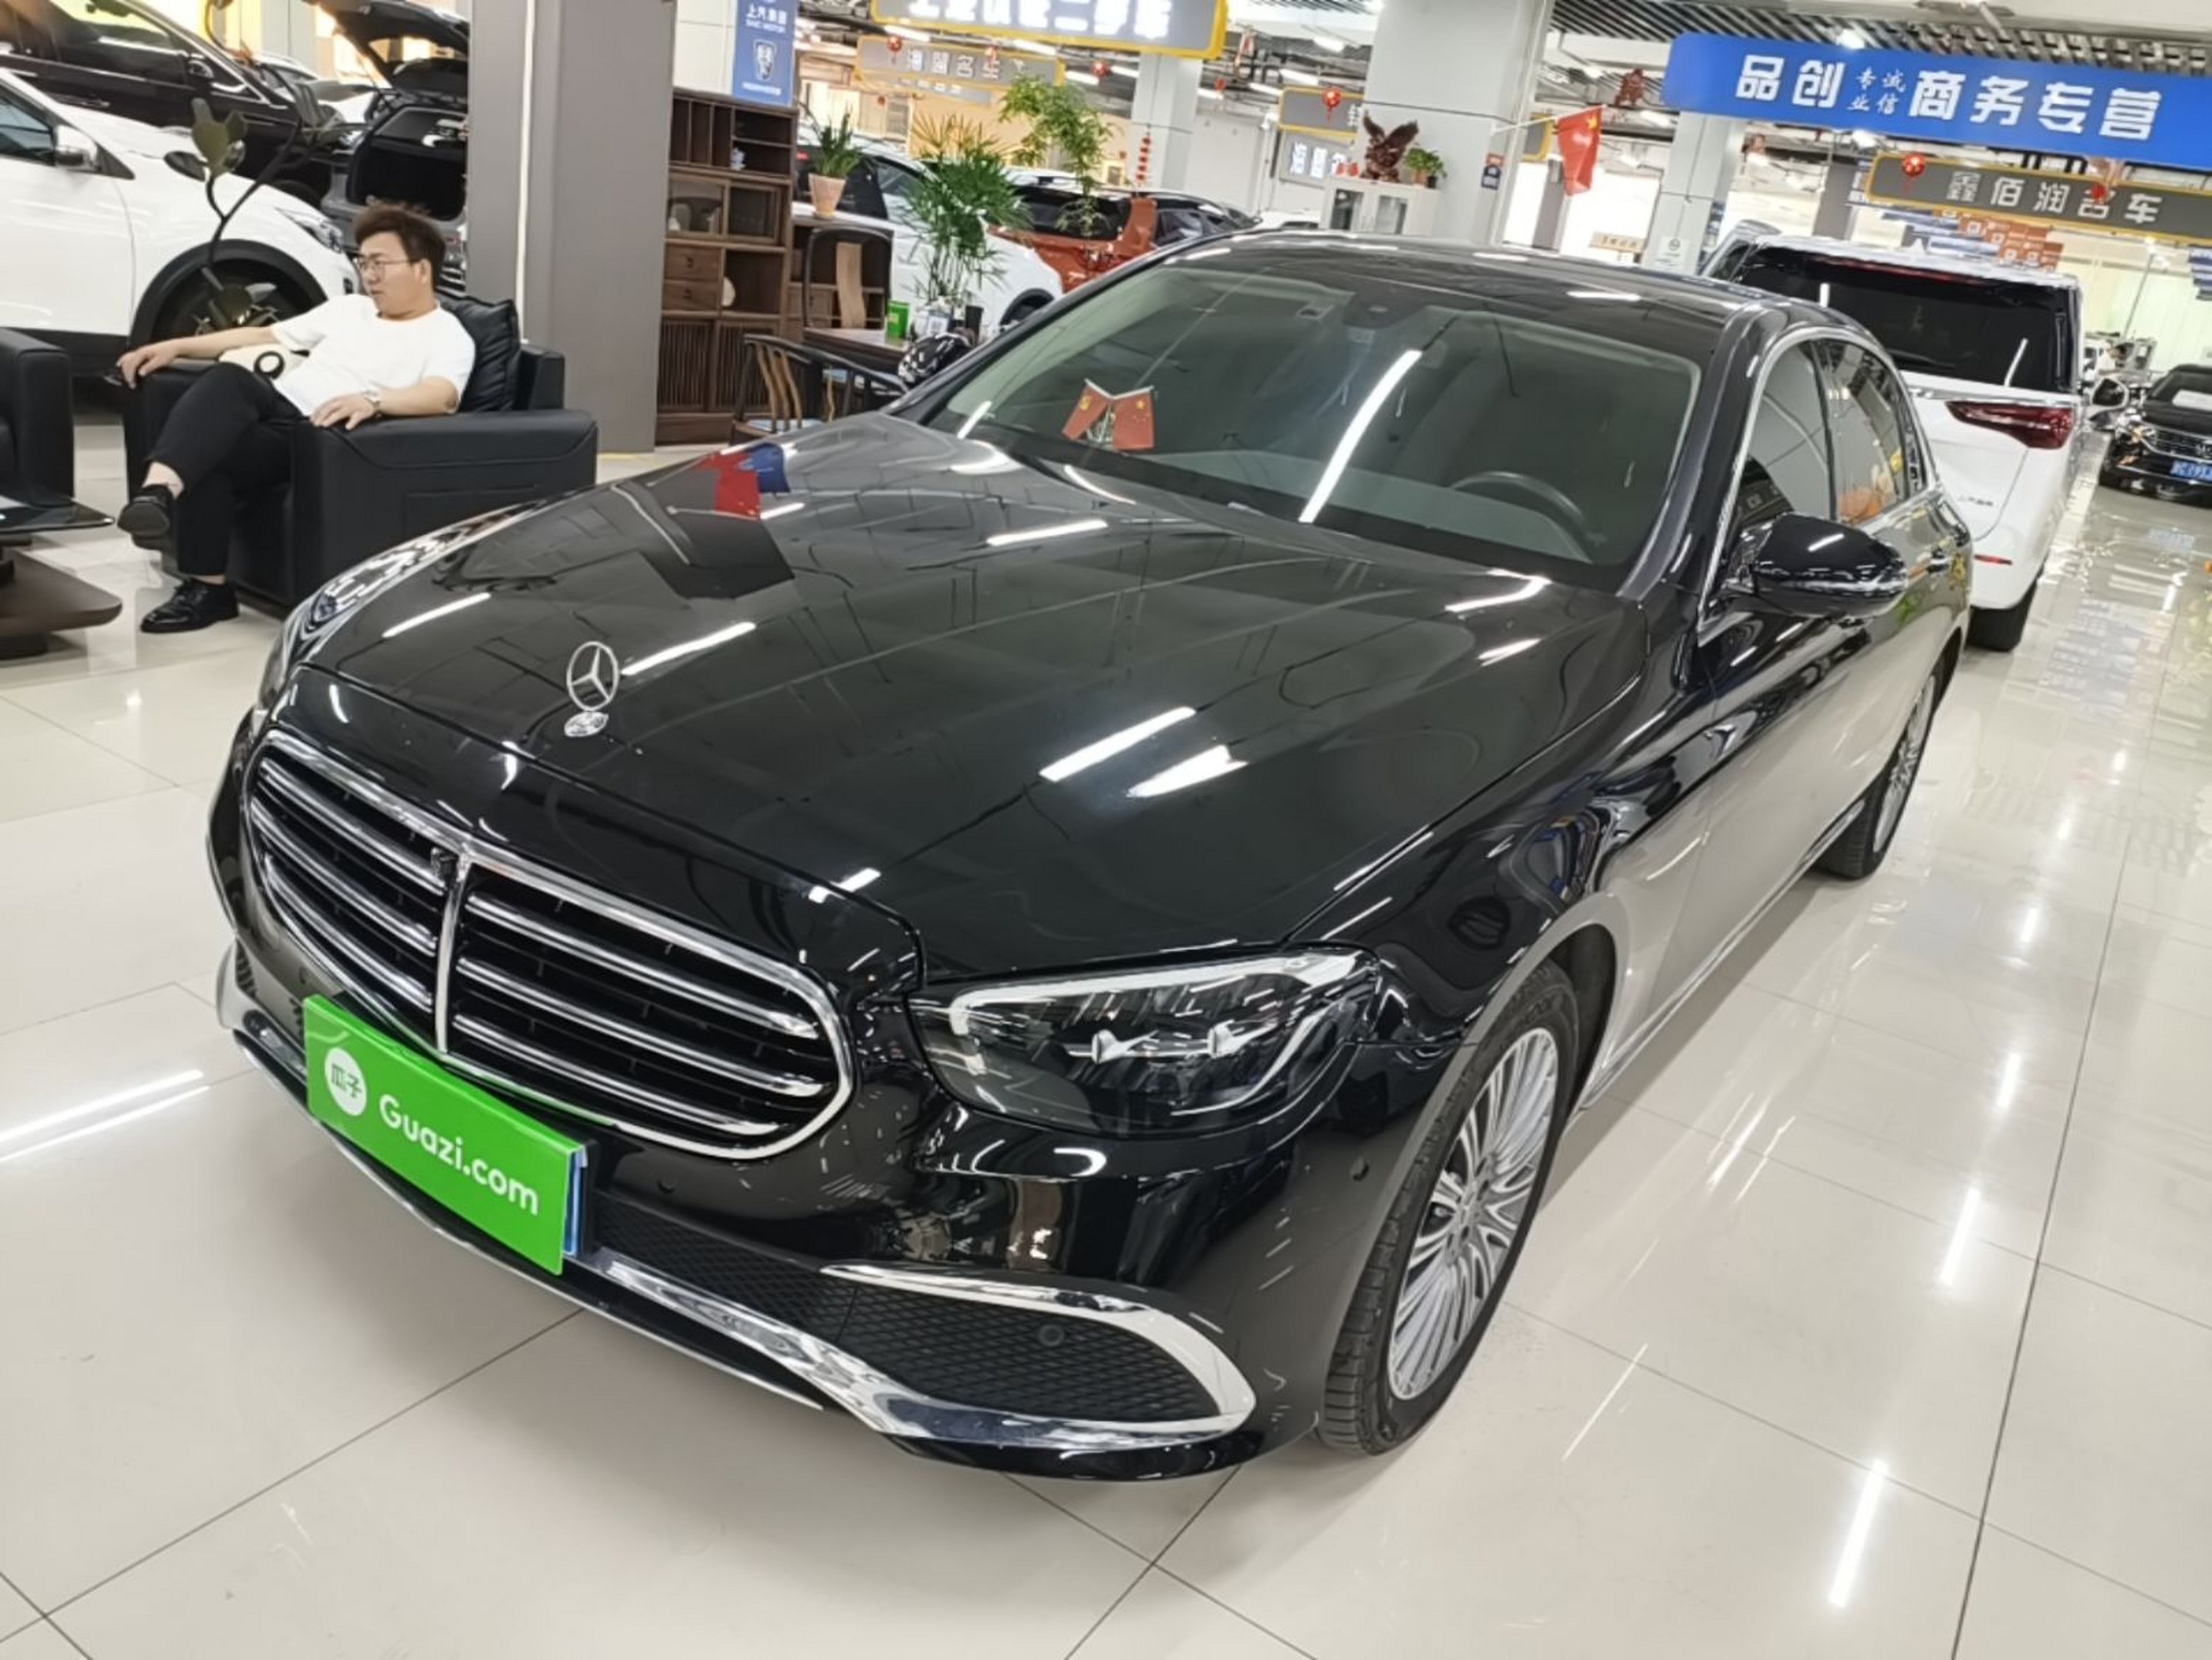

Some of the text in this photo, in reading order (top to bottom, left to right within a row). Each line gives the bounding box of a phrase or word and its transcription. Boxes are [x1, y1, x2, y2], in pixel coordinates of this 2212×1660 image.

[1735, 54, 1845, 108] 品创
[1908, 70, 2162, 140] 商务专营
[331, 1062, 362, 1098] 瓜子
[378, 1094, 539, 1216] Guazi.com
